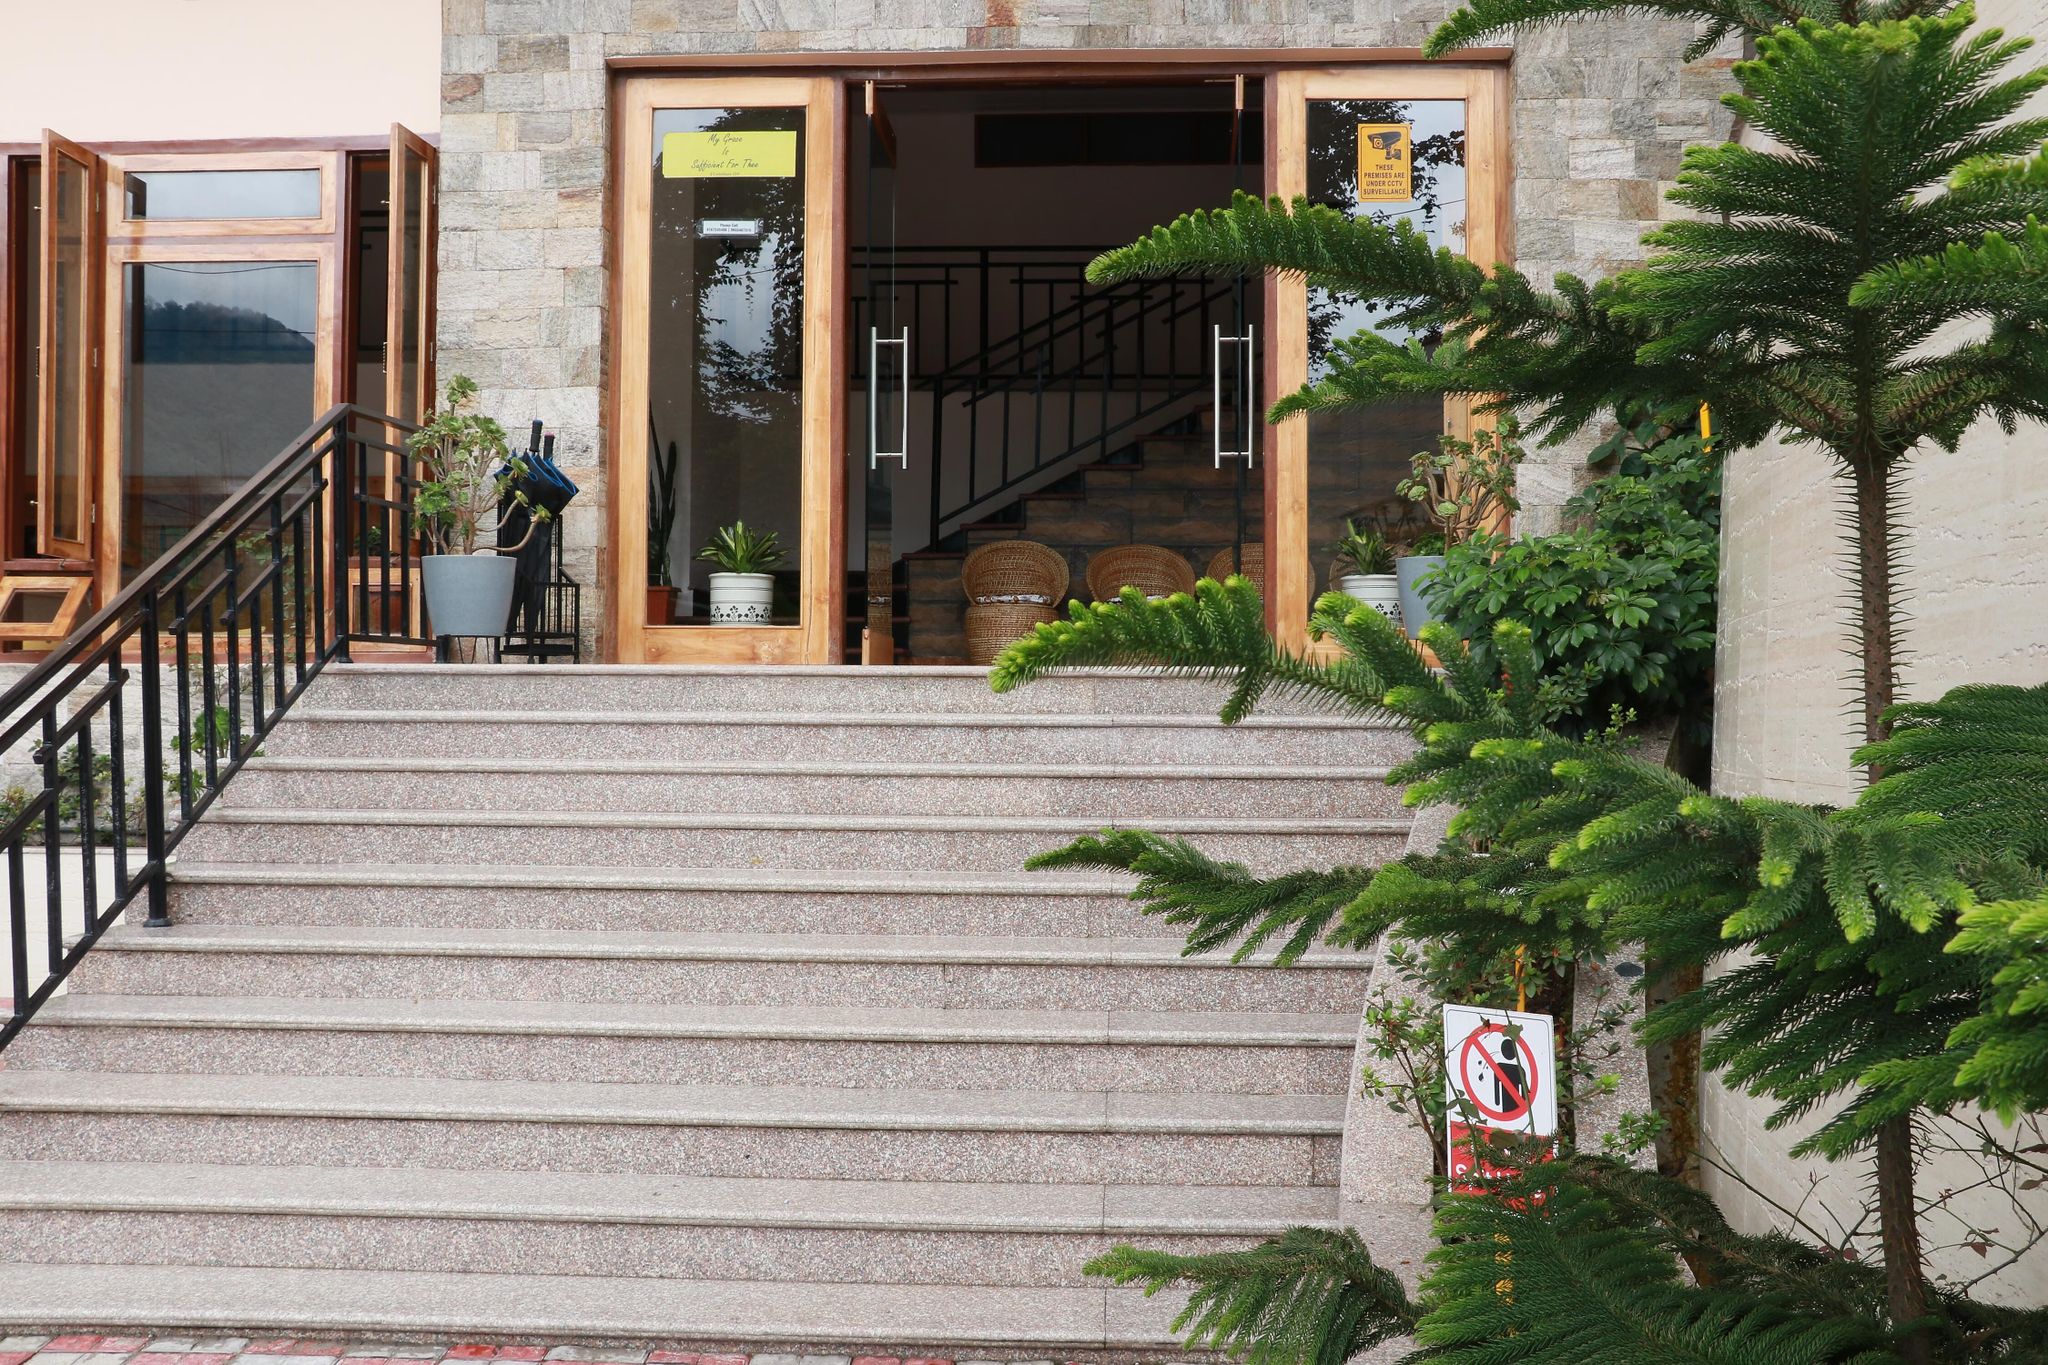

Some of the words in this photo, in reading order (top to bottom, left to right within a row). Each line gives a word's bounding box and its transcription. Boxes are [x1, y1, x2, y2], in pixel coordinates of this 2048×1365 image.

[708, 133, 720, 146] My
[723, 133, 743, 145] Grace
[691, 159, 724, 172] Sufficient
[726, 158, 739, 168] For
[743, 158, 760, 168] Thee
